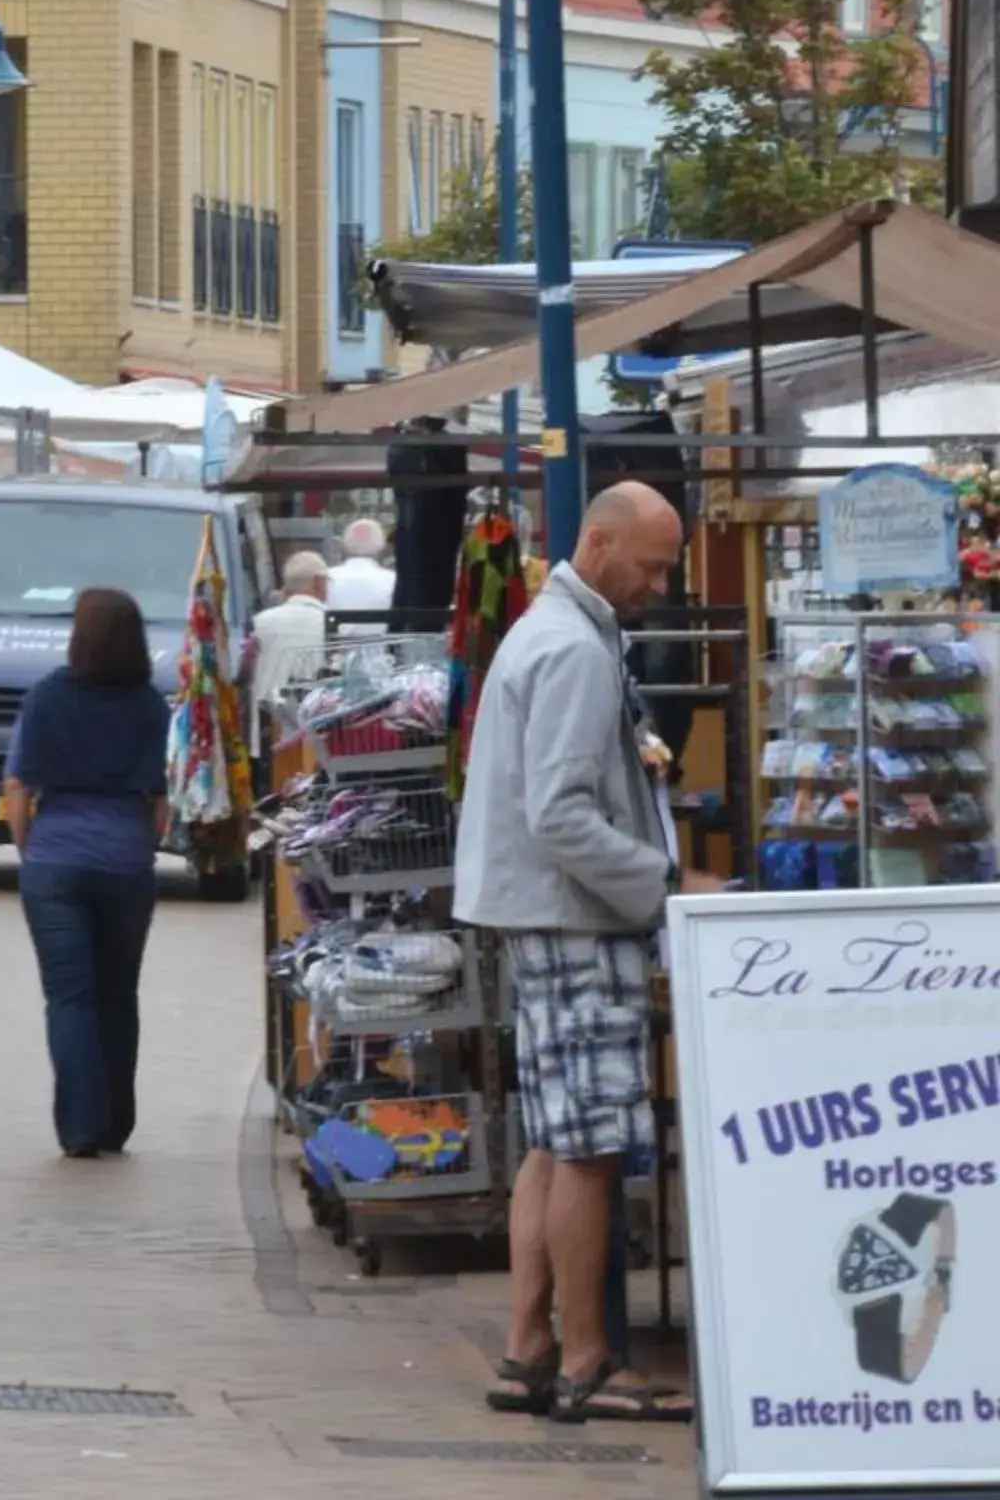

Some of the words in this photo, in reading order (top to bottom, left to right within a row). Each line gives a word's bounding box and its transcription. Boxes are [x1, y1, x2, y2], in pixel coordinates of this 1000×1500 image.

[708, 937, 810, 998] La
[720, 1111, 748, 1165] 1
[756, 1082, 882, 1156] UURS
[888, 1051, 1000, 1128] SERV
[823, 1156, 997, 1194] Horloges
[752, 1391, 913, 1434] Batterijen
[923, 1398, 963, 1423] en
[973, 1389, 1000, 1422] b
